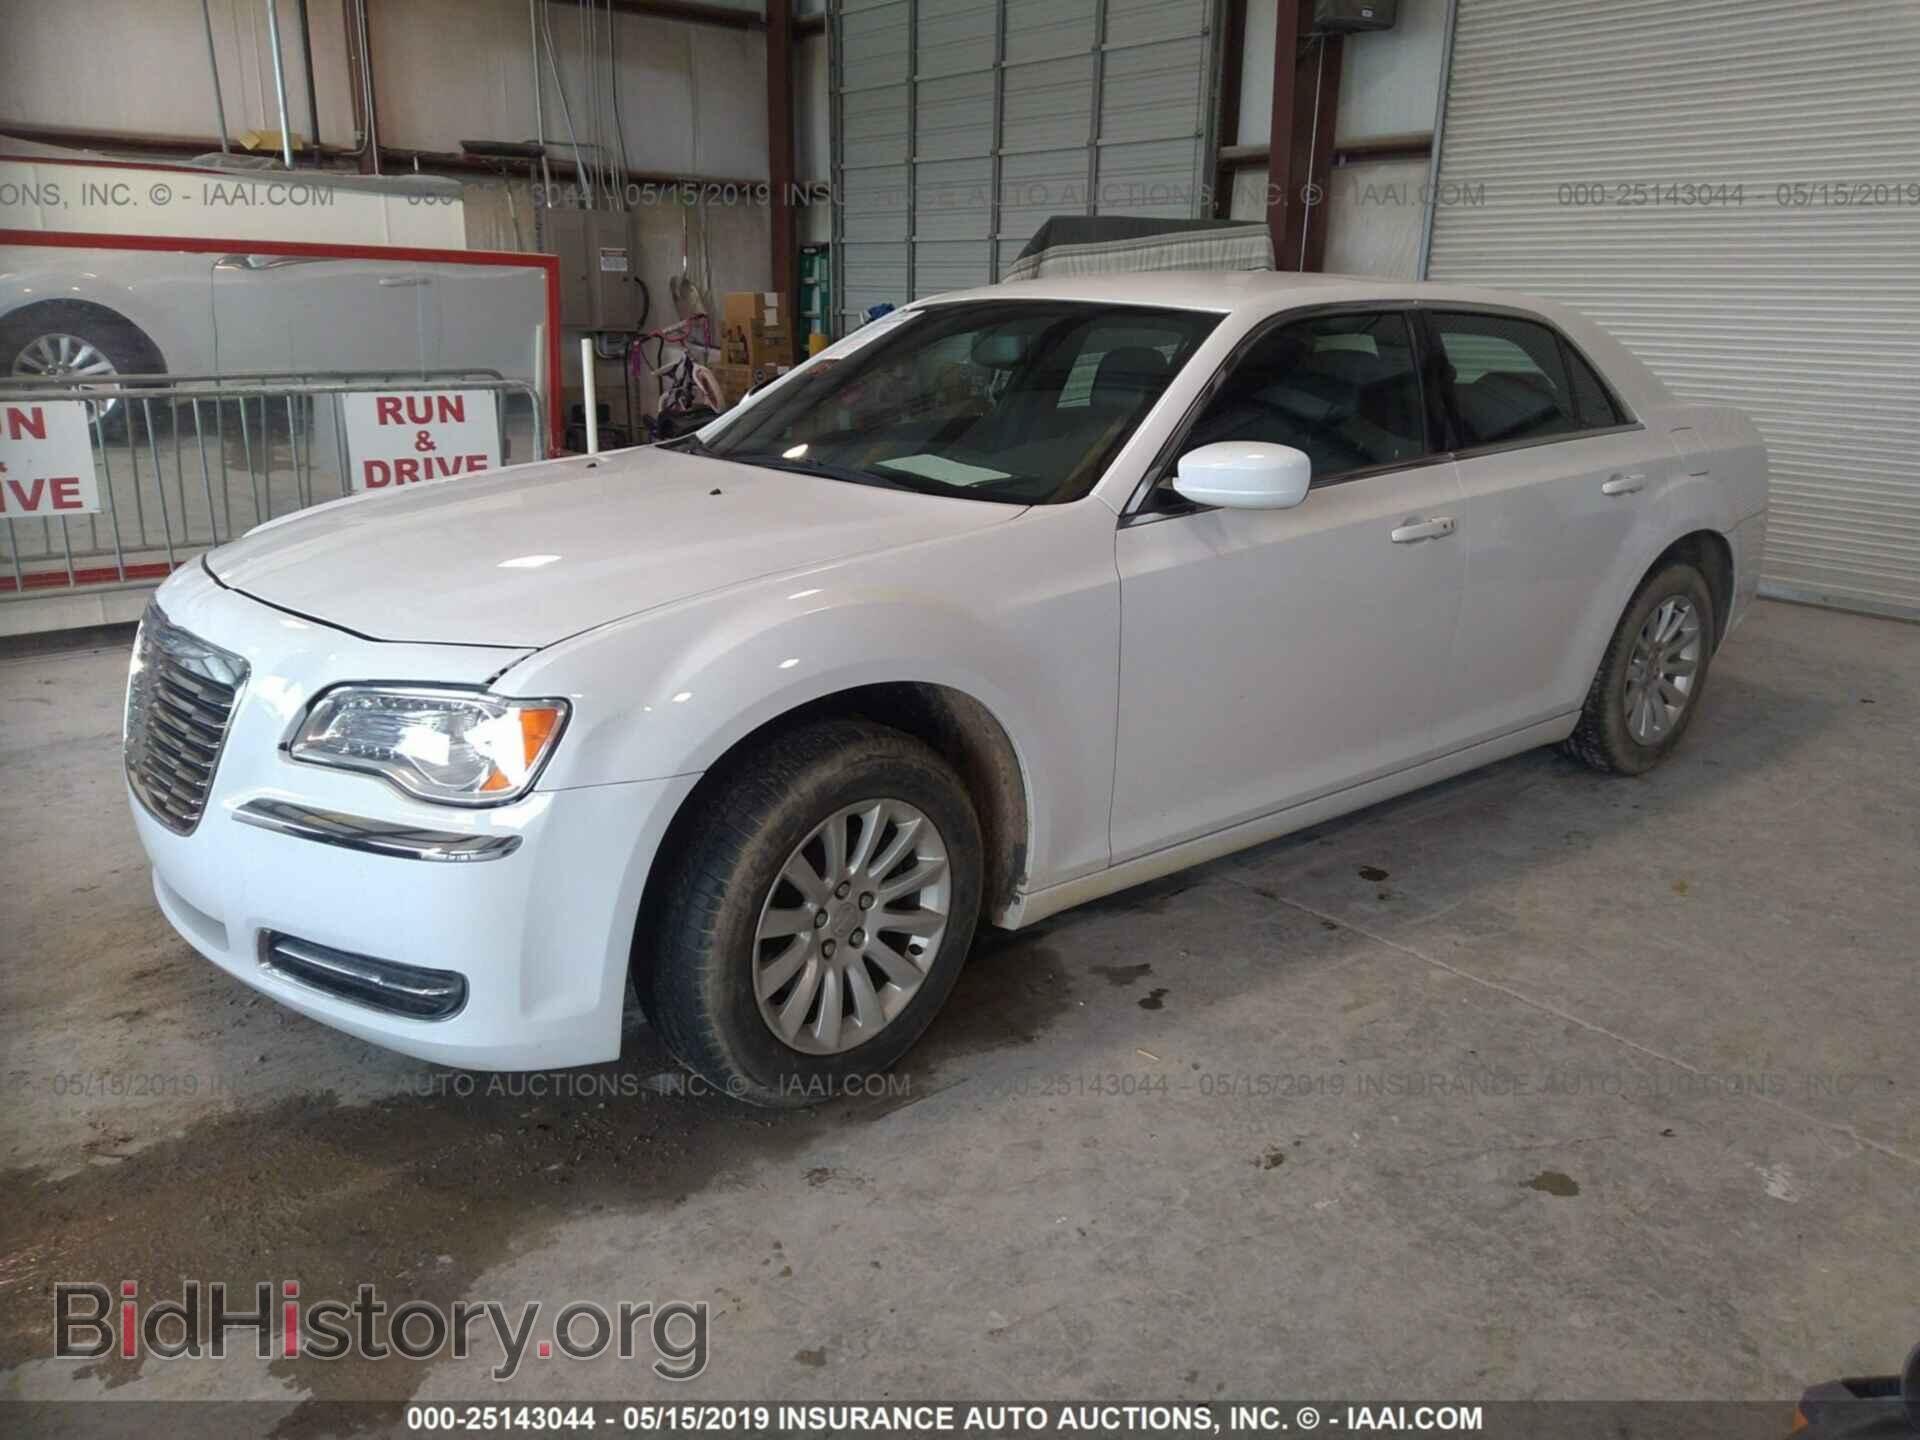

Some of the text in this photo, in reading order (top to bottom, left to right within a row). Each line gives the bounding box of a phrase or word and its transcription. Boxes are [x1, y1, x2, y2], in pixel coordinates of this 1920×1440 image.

[0, 407, 47, 440] N
[376, 395, 465, 425] RUN
[415, 430, 437, 452] &
[364, 454, 488, 489] DRIVE
